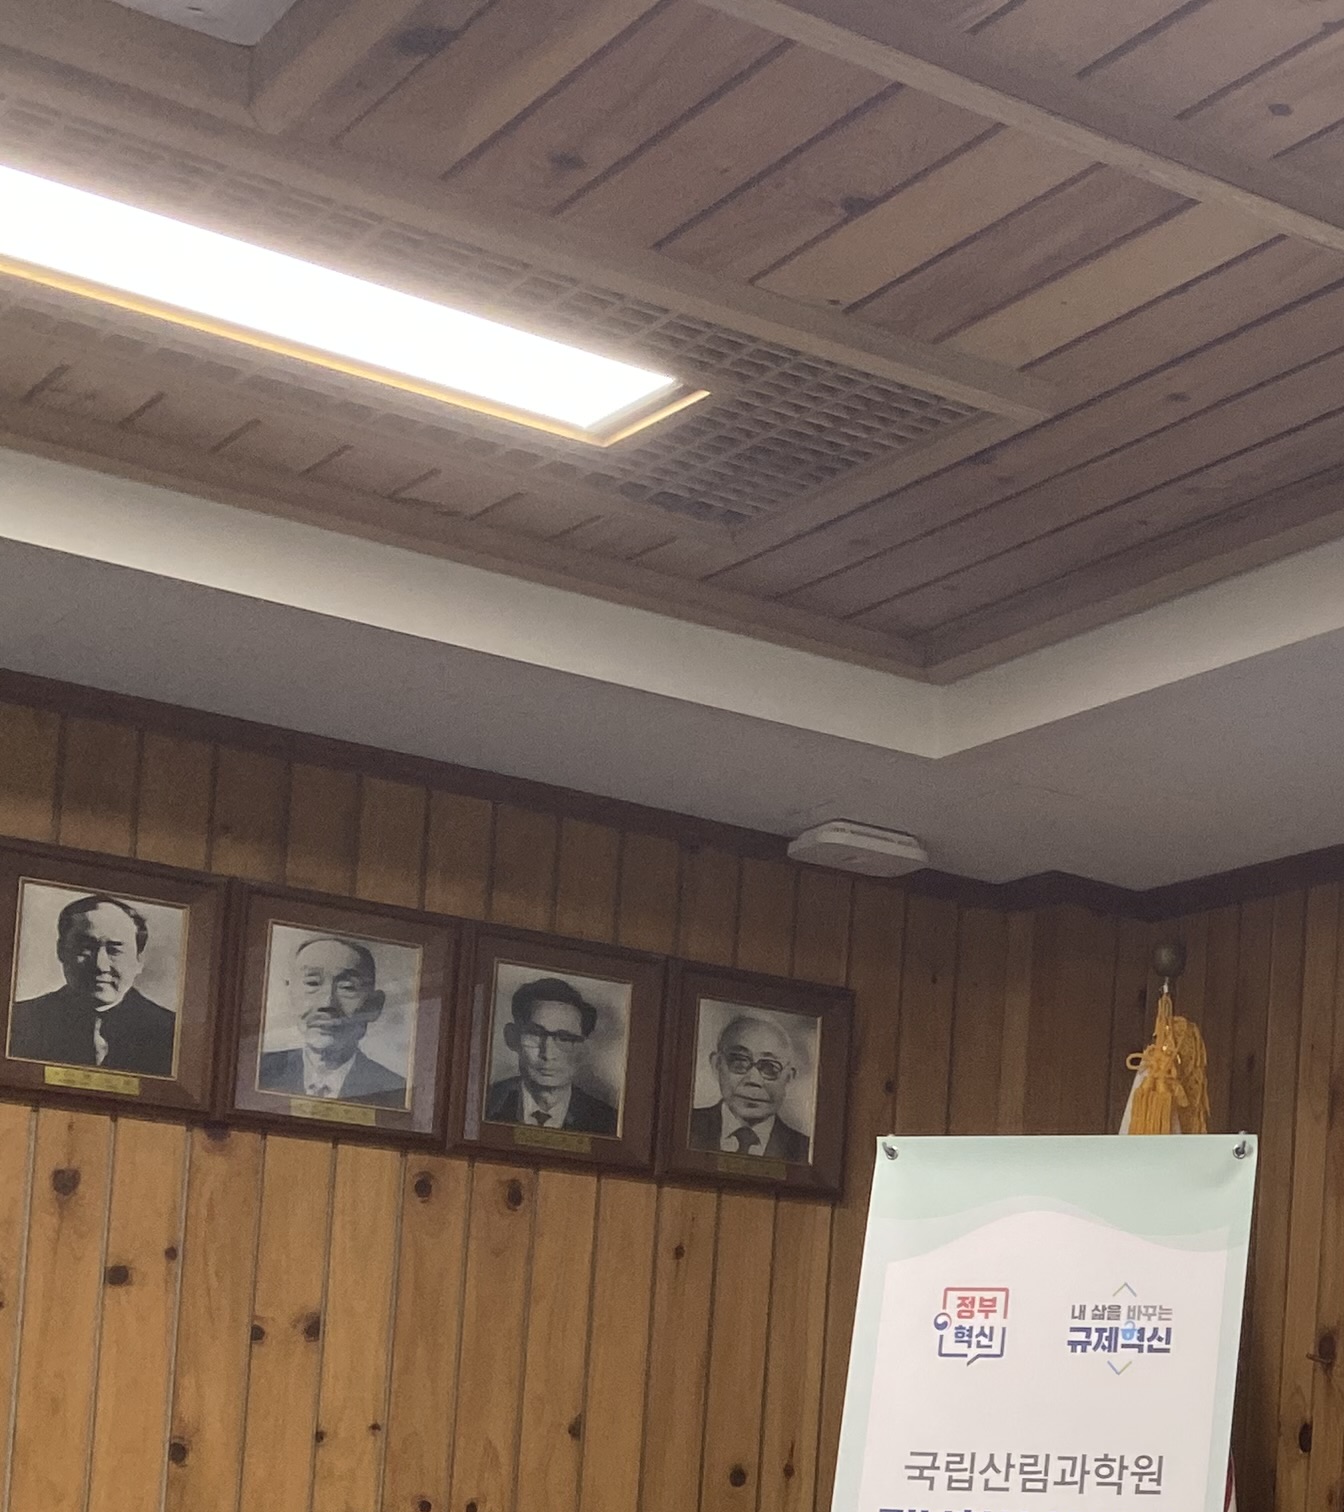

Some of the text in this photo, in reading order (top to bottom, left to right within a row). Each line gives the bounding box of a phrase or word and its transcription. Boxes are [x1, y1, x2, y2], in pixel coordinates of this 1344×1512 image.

[956, 1297, 998, 1320] 정부
[1071, 1304, 1173, 1321] 내 삶을 바꾸는
[953, 1325, 995, 1349] 혁신
[904, 1451, 1165, 1495] 국립산림과학원
